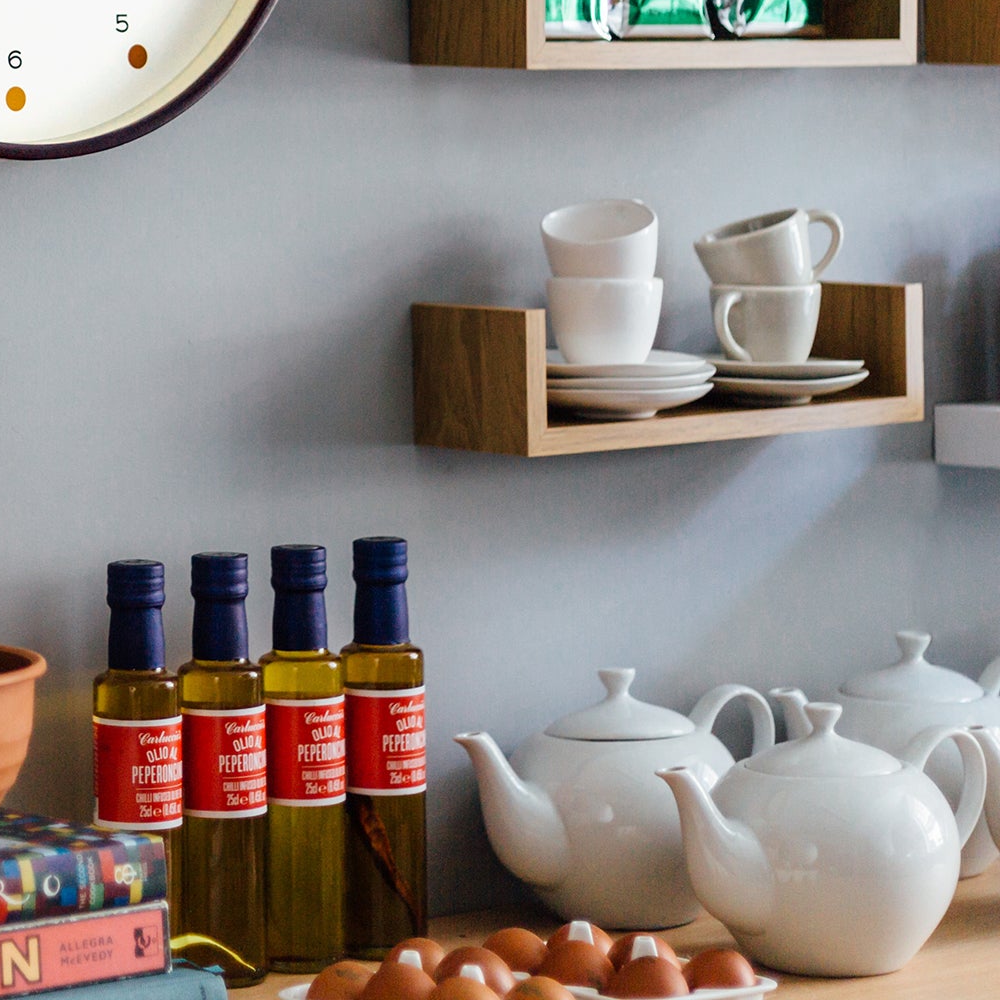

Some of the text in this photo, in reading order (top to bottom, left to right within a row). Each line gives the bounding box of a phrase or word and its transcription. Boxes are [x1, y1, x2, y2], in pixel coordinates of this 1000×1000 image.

[116, 14, 129, 33] 5
[8, 50, 22, 69] 6
[396, 715, 417, 732] OLIO
[312, 725, 333, 742] OLIO
[233, 735, 254, 752] OLIO
[146, 746, 169, 763] OLIO
[76, 854, 87, 909] THE SECOND
[88, 856, 96, 905] COOKBOOK
[60, 935, 113, 953] ALLEGRA
[60, 949, 113, 966] McEVEDY
